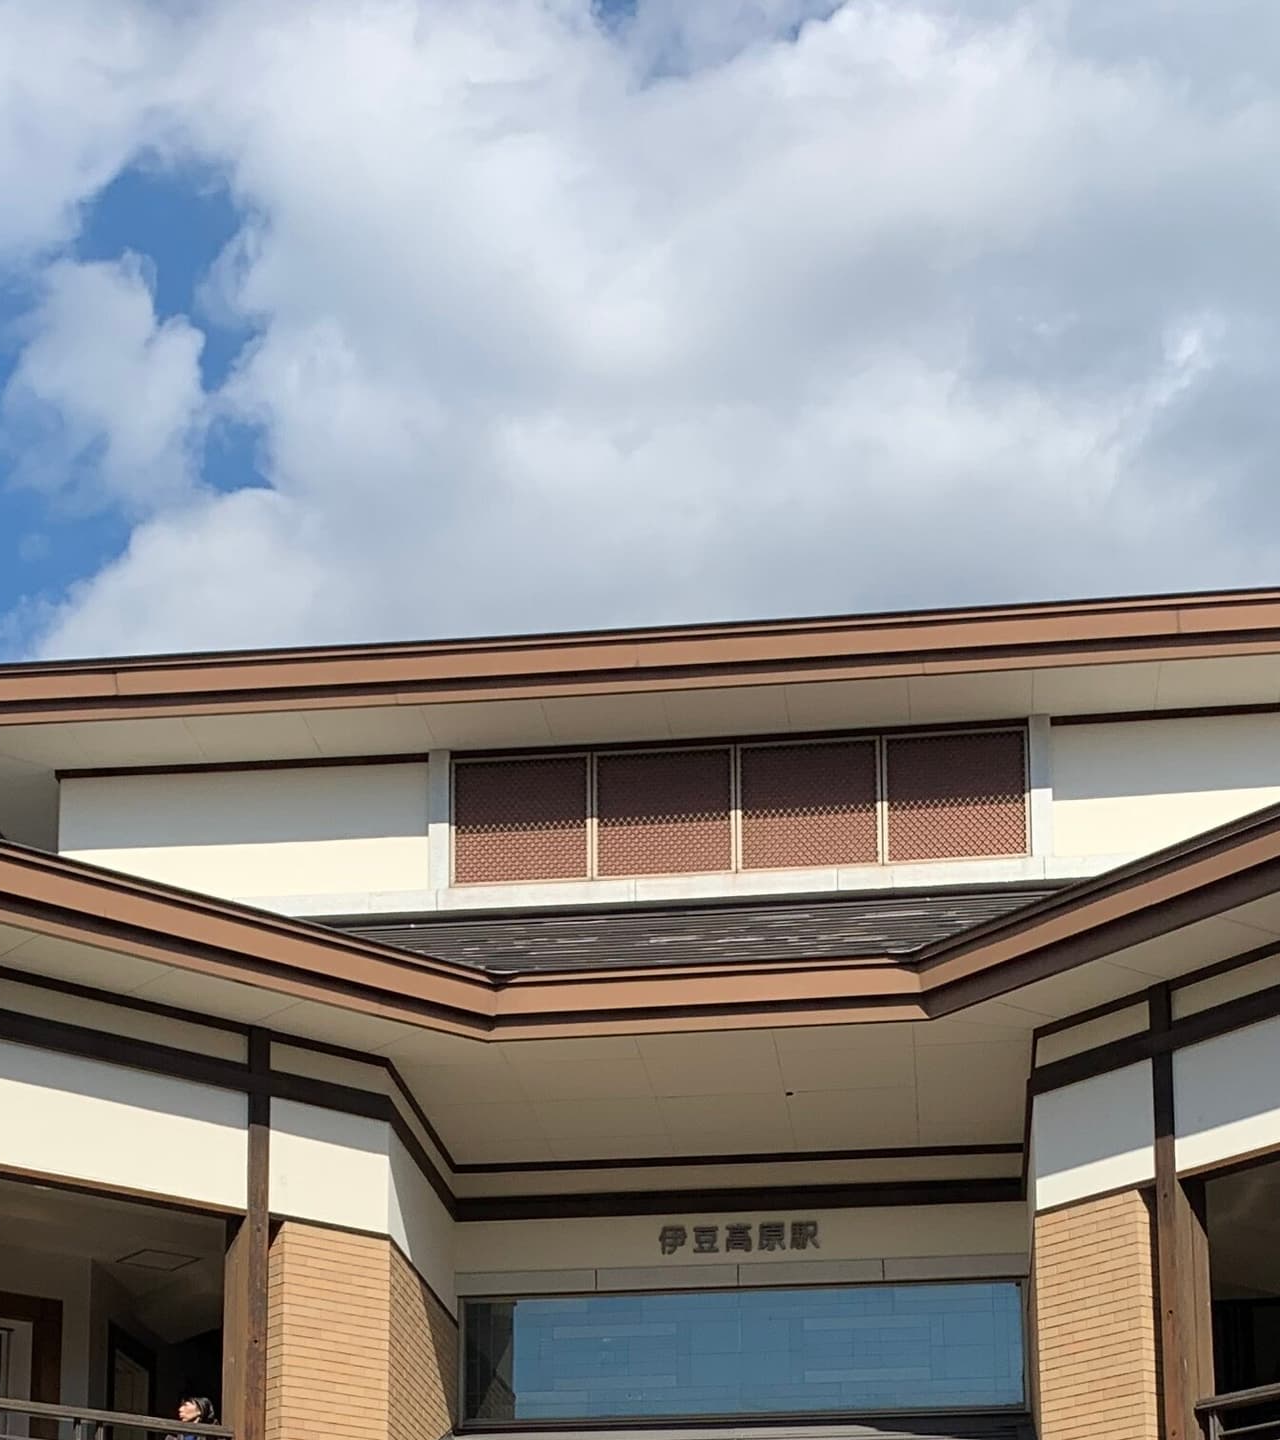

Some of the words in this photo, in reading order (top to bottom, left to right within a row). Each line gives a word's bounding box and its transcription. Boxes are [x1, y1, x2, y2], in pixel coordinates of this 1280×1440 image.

[658, 1219, 820, 1255] 伊豆高原駅
